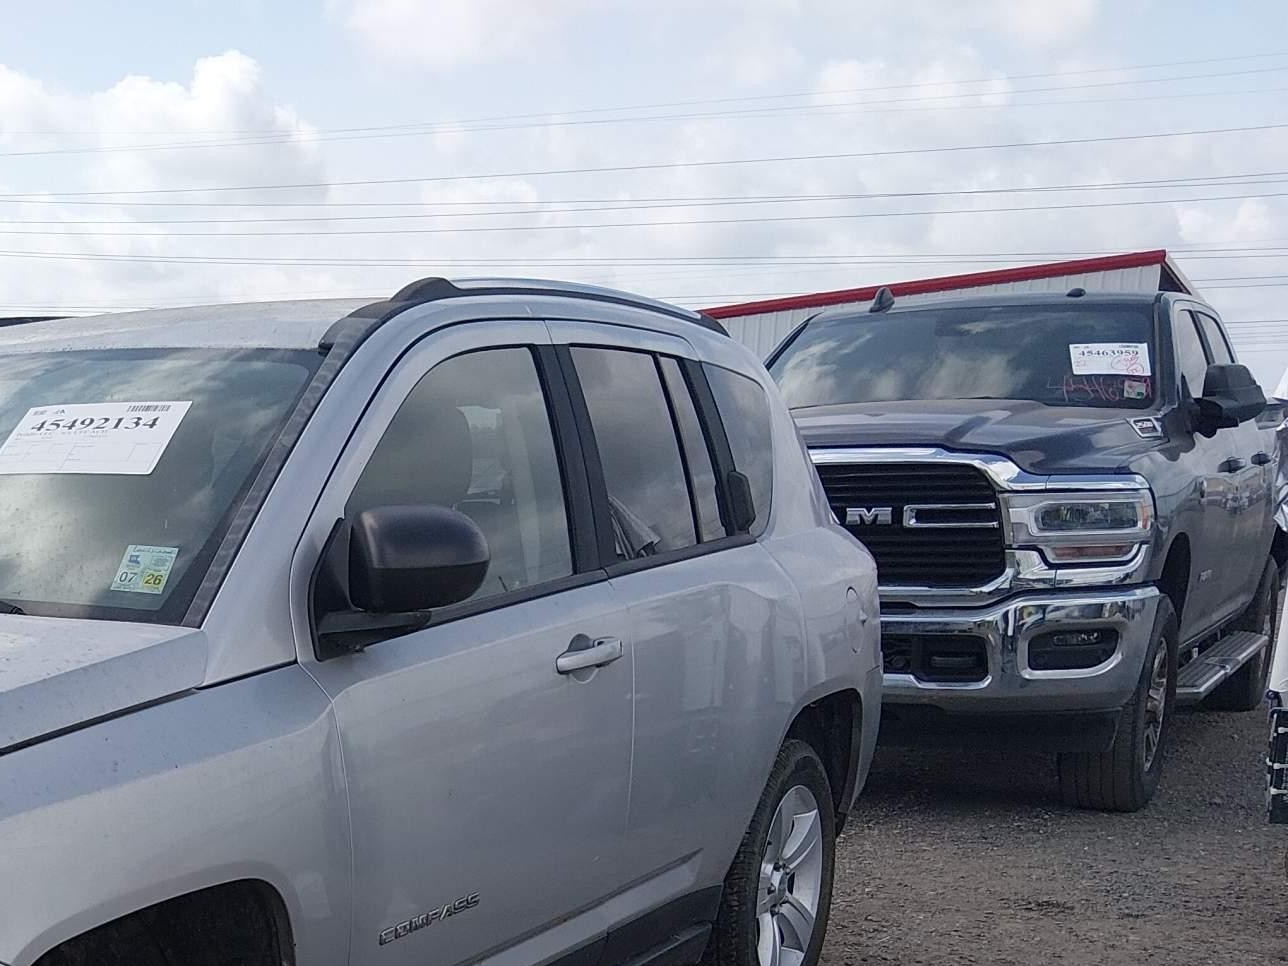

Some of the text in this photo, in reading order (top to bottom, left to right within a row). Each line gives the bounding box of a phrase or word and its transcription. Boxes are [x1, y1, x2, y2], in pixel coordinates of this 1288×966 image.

[1078, 348, 1139, 357] 45463959
[30, 416, 161, 432] 45492134
[119, 571, 164, 585] 07 26
[379, 891, 481, 946] COMPASS
